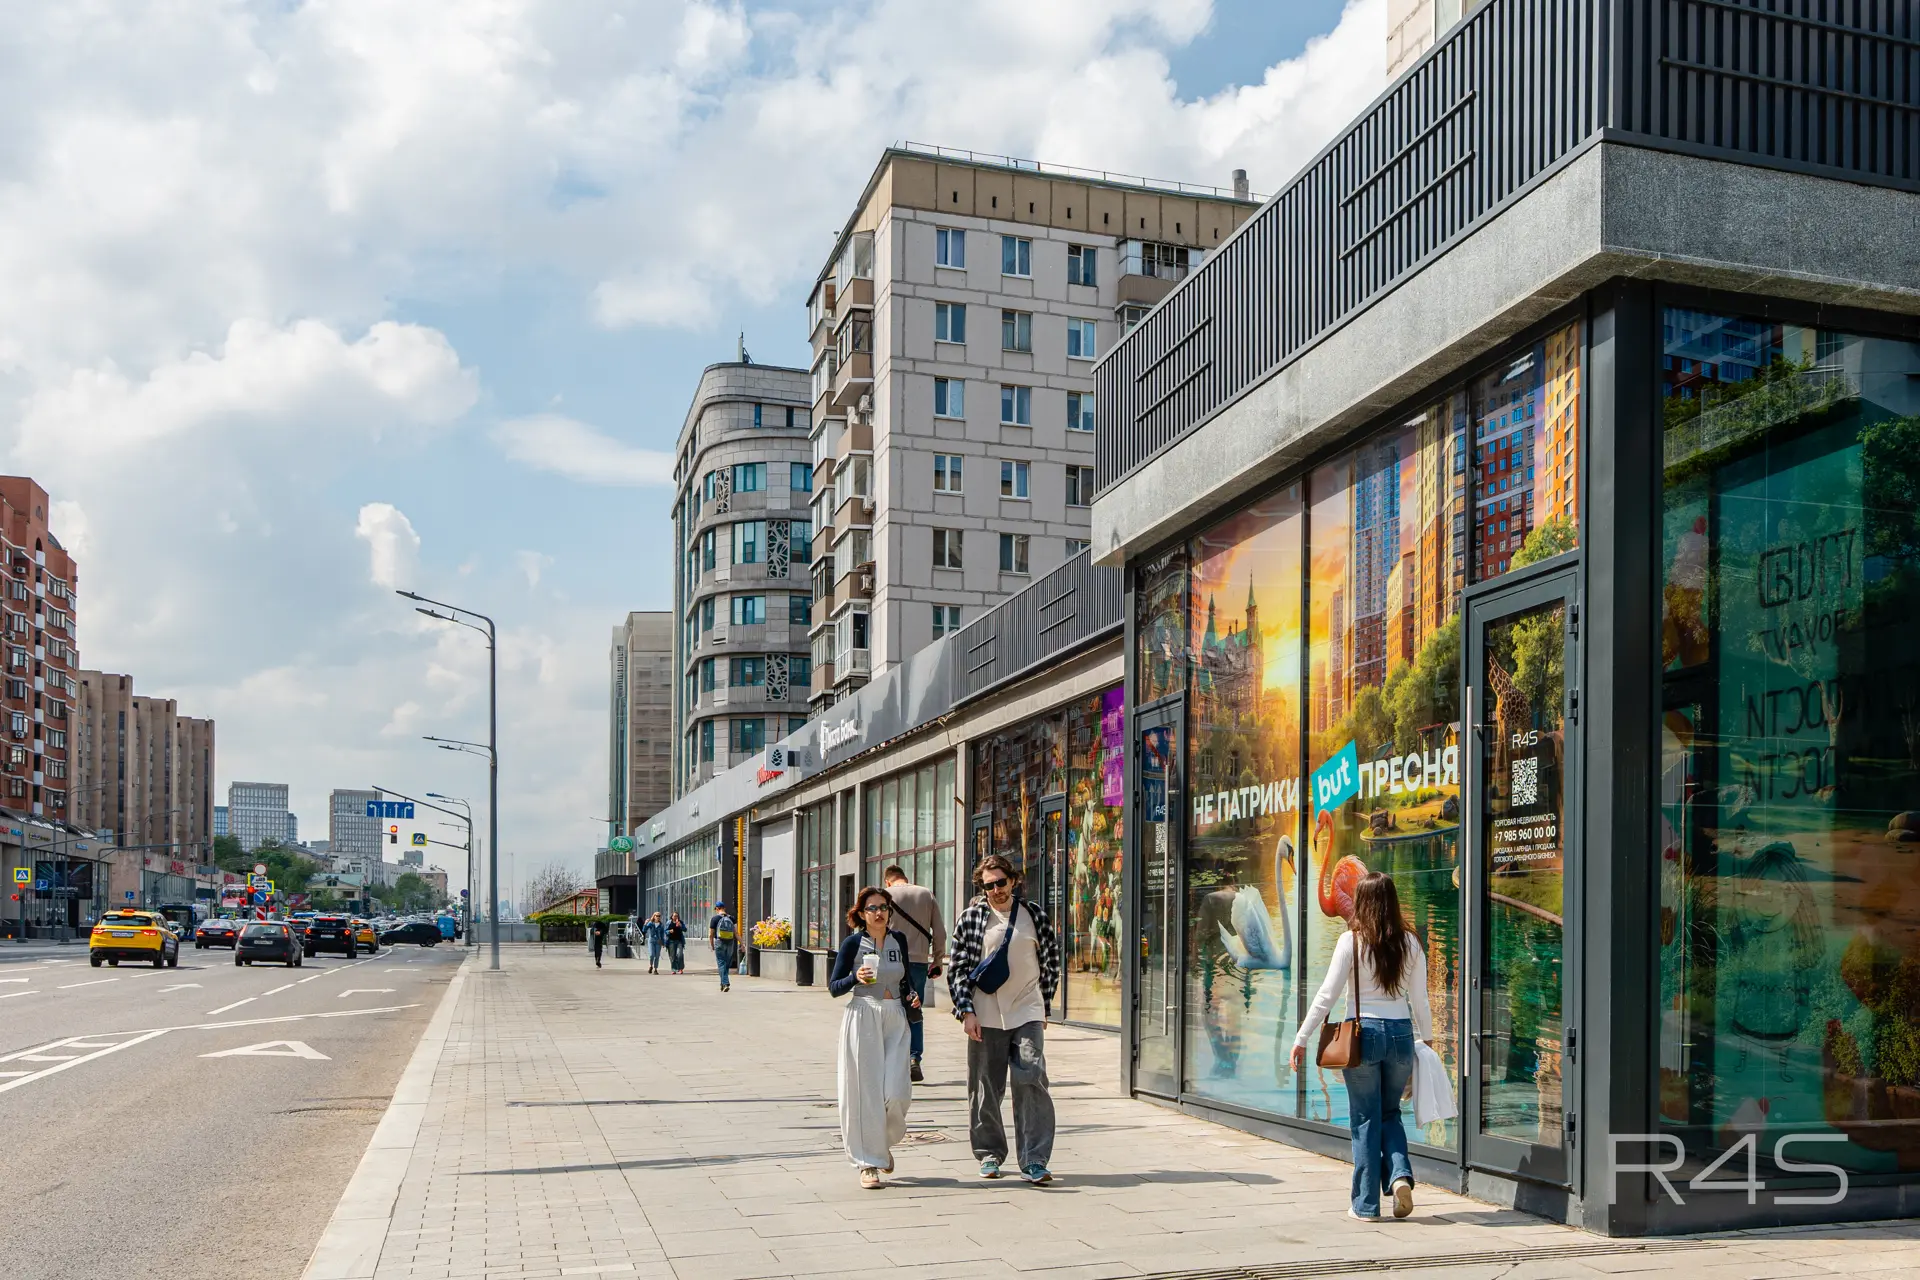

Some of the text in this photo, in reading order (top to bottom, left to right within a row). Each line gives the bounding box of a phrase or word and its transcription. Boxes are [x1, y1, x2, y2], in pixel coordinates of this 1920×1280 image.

[1512, 729, 1539, 749] R4S
[1317, 756, 1352, 807] but
[1357, 744, 1459, 800] ПРЕСНЯ
[1193, 776, 1300, 826] НЕ ПАТРИКИ
[1494, 812, 1557, 828] ТОРГОВАЯ НЕДВИЖИМОСТЬ
[1494, 825, 1557, 843] +7 985 960 00 00
[1534, 842, 1557, 851] ПРОДАЖА
